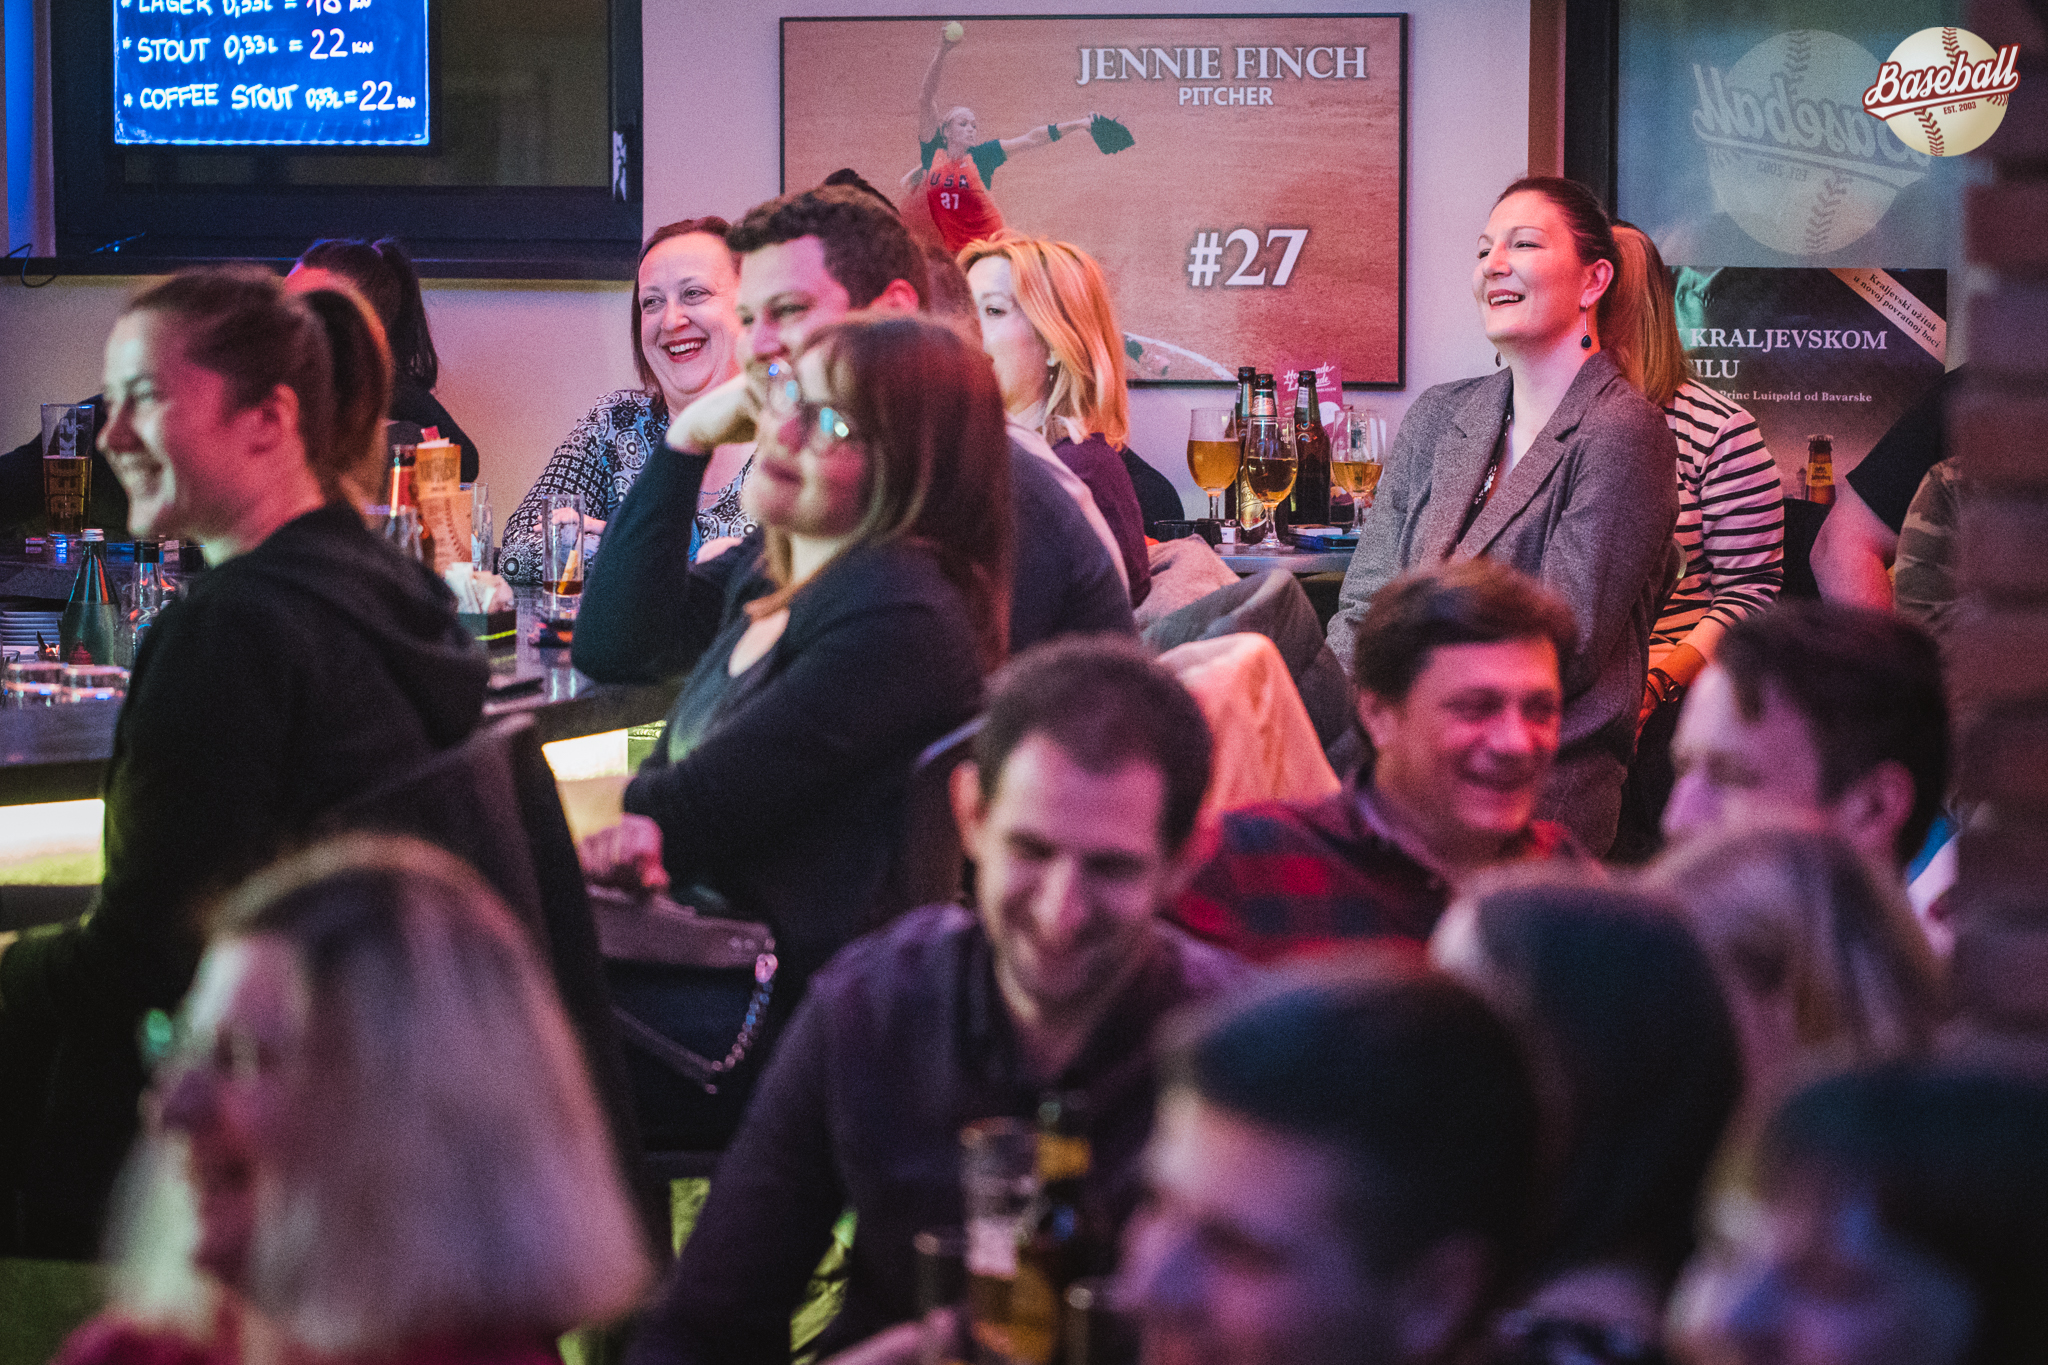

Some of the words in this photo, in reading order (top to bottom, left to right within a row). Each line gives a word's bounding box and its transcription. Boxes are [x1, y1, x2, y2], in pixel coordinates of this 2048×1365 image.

[138, 37, 211, 64] STOUT
[309, 28, 348, 60] 22
[1076, 47, 1221, 85] JENNIE
[1235, 46, 1368, 79] FINCH
[140, 83, 219, 110] COFFEE
[231, 83, 299, 111] STOUT
[1178, 86, 1274, 106] PITCHER
[930, 172, 969, 188] USA
[1188, 228, 1309, 287] #27
[1860, 282, 1884, 302] novoj
[1882, 300, 1923, 334] povratnoj
[1921, 330, 1941, 348] boci
[1869, 274, 1912, 310] Kraljevski
[1911, 309, 1937, 332] užitak
[1689, 328, 1888, 352] KRALJEVSKOM
[1689, 359, 1740, 378] ILU
[1753, 390, 1801, 403] Luitpold
[1804, 391, 1818, 401] od
[1822, 392, 1872, 402] Bavarske
